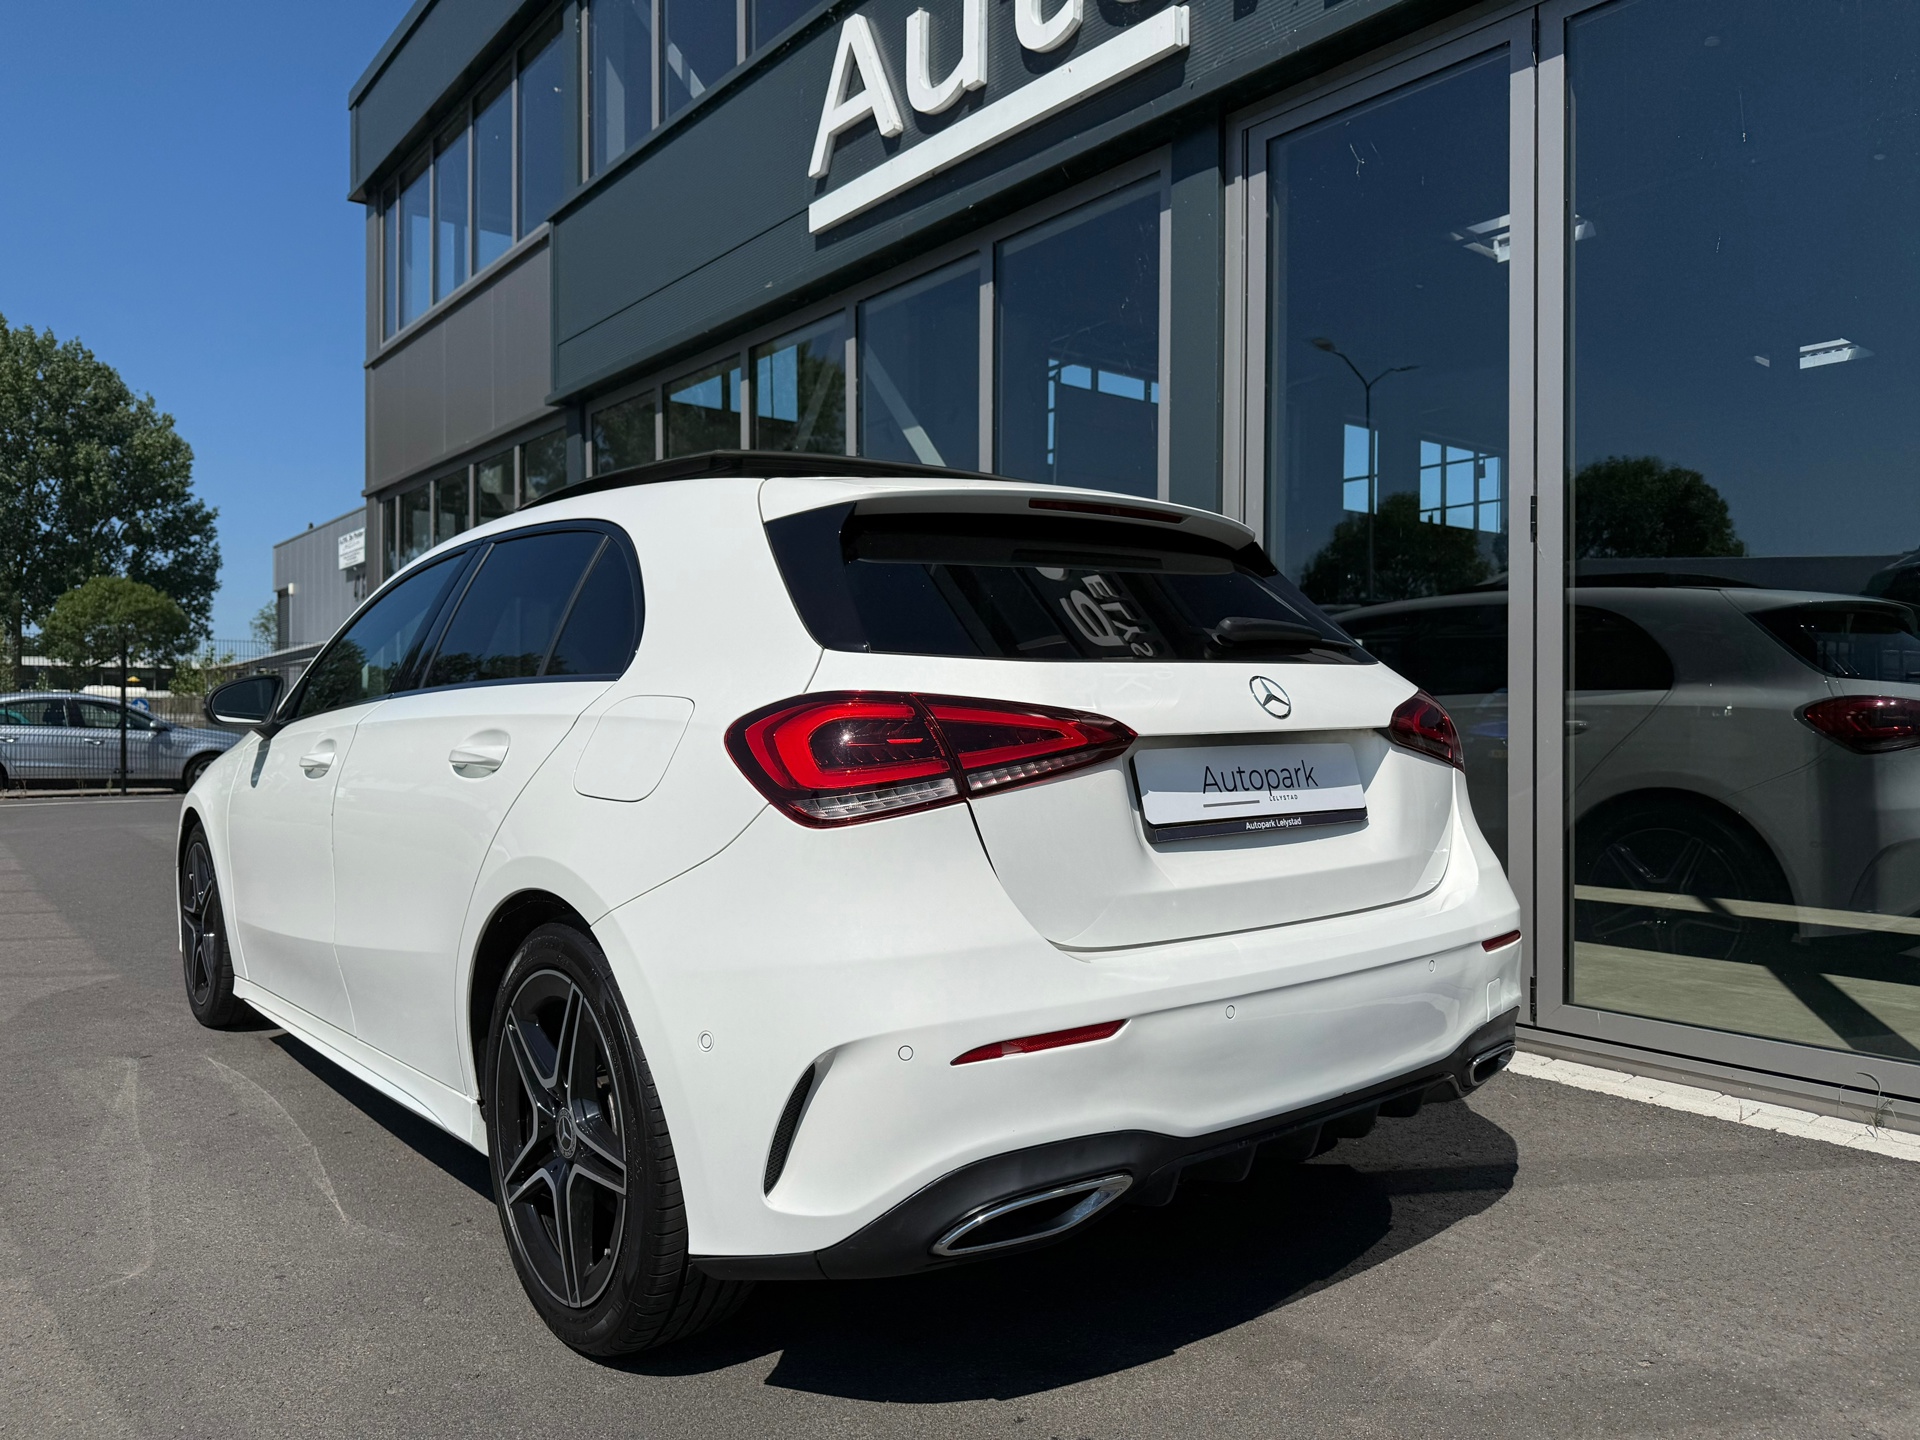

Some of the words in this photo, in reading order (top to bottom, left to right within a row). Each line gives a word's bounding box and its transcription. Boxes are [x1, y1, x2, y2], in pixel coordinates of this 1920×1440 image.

[1203, 760, 1319, 796] Autopark
[1269, 794, 1299, 802] LELYSTAD
[1246, 819, 1276, 830] Autopark
[1276, 817, 1302, 827] Lelystad
